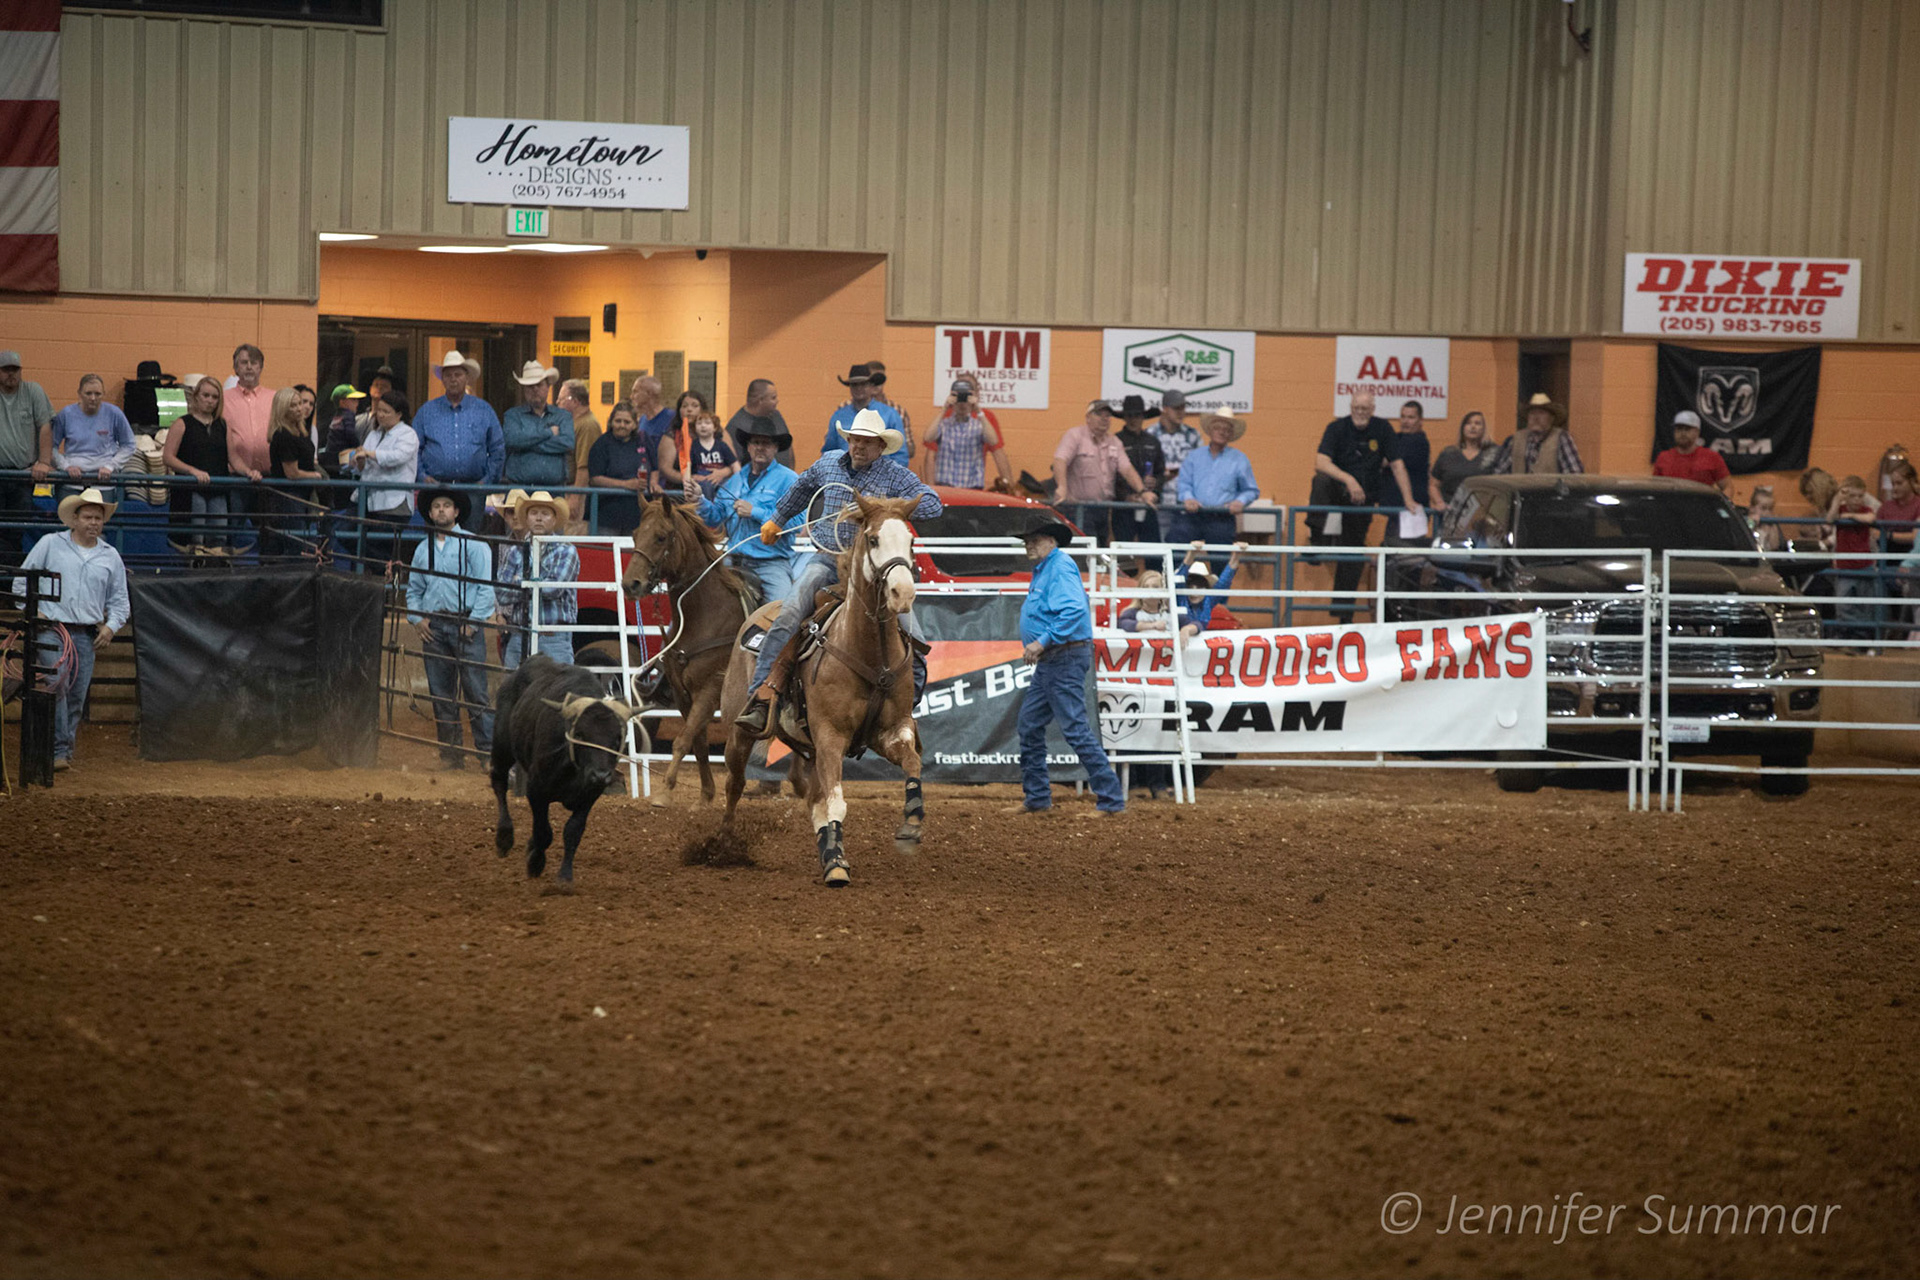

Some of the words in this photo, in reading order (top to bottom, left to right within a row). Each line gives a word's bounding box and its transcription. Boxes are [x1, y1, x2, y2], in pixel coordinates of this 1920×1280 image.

[476, 123, 663, 166] Hometown
[528, 166, 613, 185] DESIGNS
[513, 184, 550, 199] (205)
[556, 185, 627, 200] 767-4954
[515, 210, 544, 233] EXIT
[1636, 258, 1850, 298] DIXIE
[1658, 295, 1827, 316] TRUCKING
[1660, 317, 1715, 334] (205)
[1722, 318, 1822, 334] 983-7965
[553, 344, 588, 354] SECURITY
[943, 329, 1041, 369] TVM
[1184, 350, 1220, 364] R&B
[1357, 355, 1428, 381] AAA
[977, 382, 1016, 392] ALLEY
[978, 394, 1016, 404] ETALS
[1093, 638, 1176, 686] ME
[1202, 631, 1370, 688] RODEO
[1396, 621, 1533, 682] FANS
[911, 679, 974, 719] ast
[985, 663, 1037, 699] Ba
[1161, 700, 1347, 732] RAM
